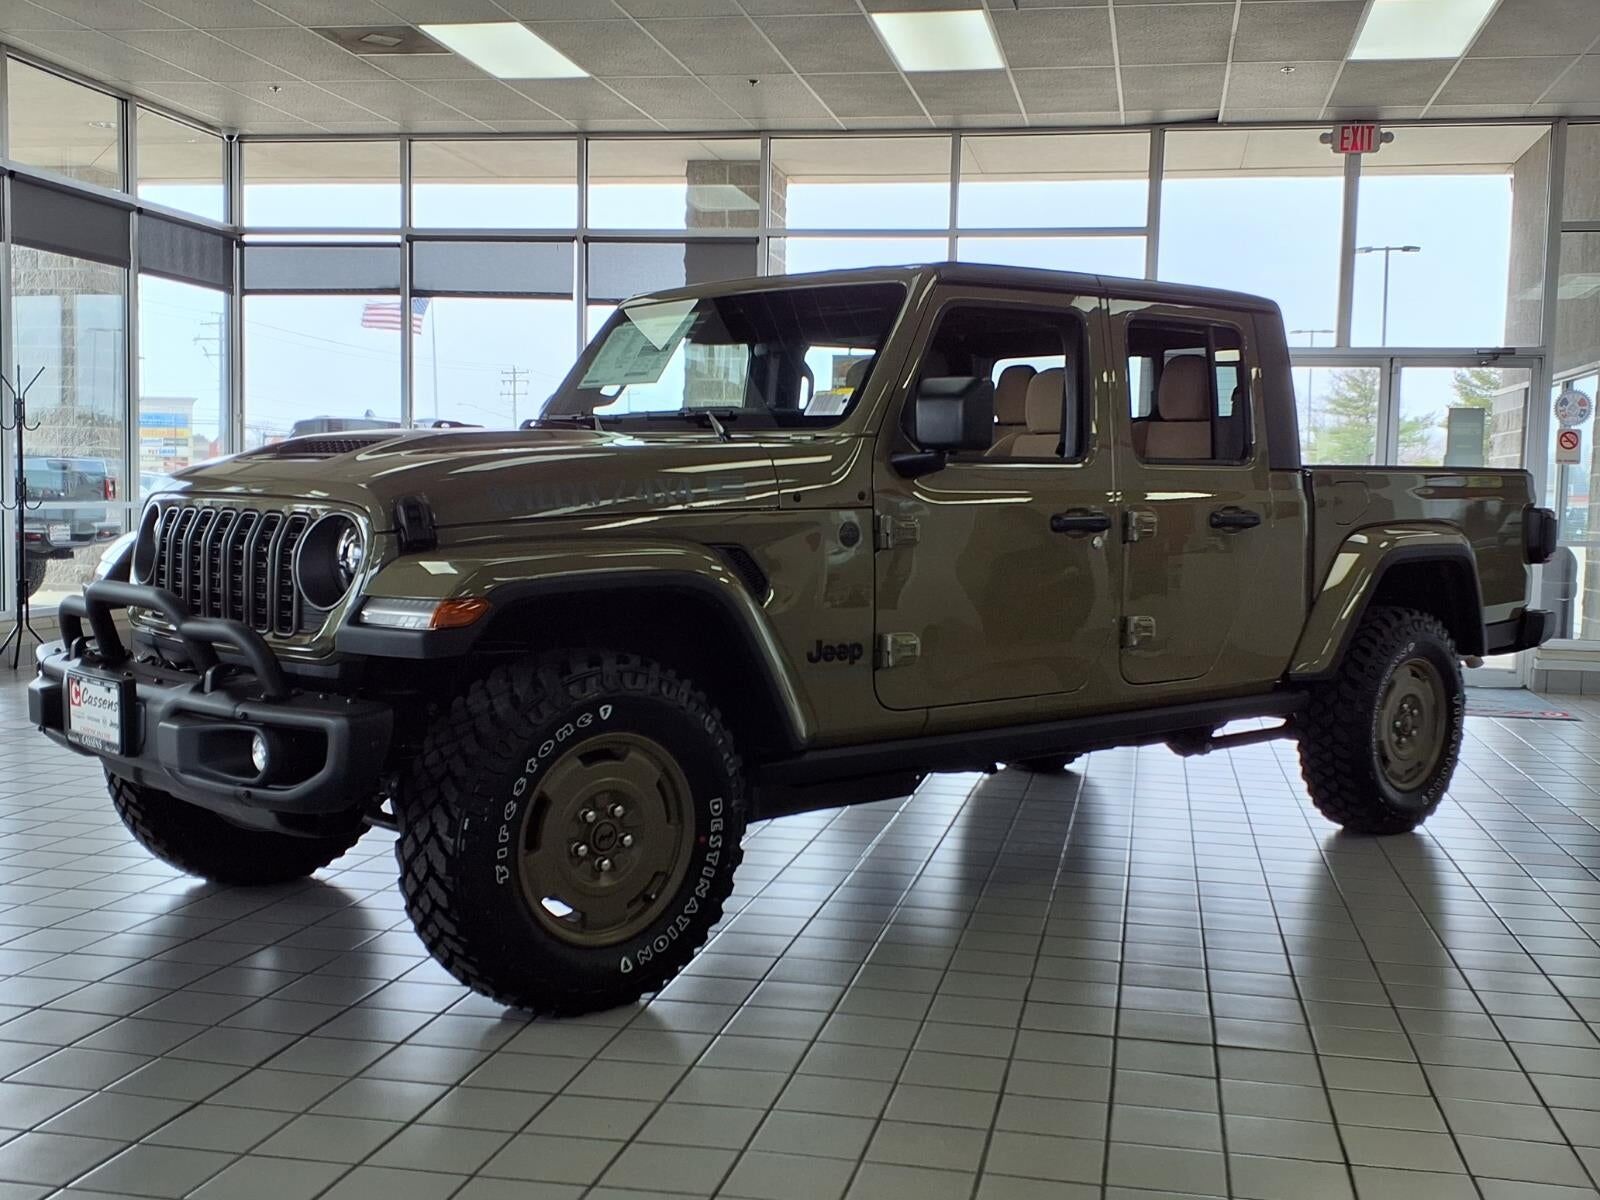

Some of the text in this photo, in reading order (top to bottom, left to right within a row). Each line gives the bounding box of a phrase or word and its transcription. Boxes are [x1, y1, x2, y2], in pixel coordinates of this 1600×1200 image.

[1340, 125, 1376, 151] EXIT
[806, 640, 864, 665] Jeep
[81, 687, 118, 713] Cassens
[494, 712, 594, 885] Firestone
[636, 797, 724, 965] DESTINATION
